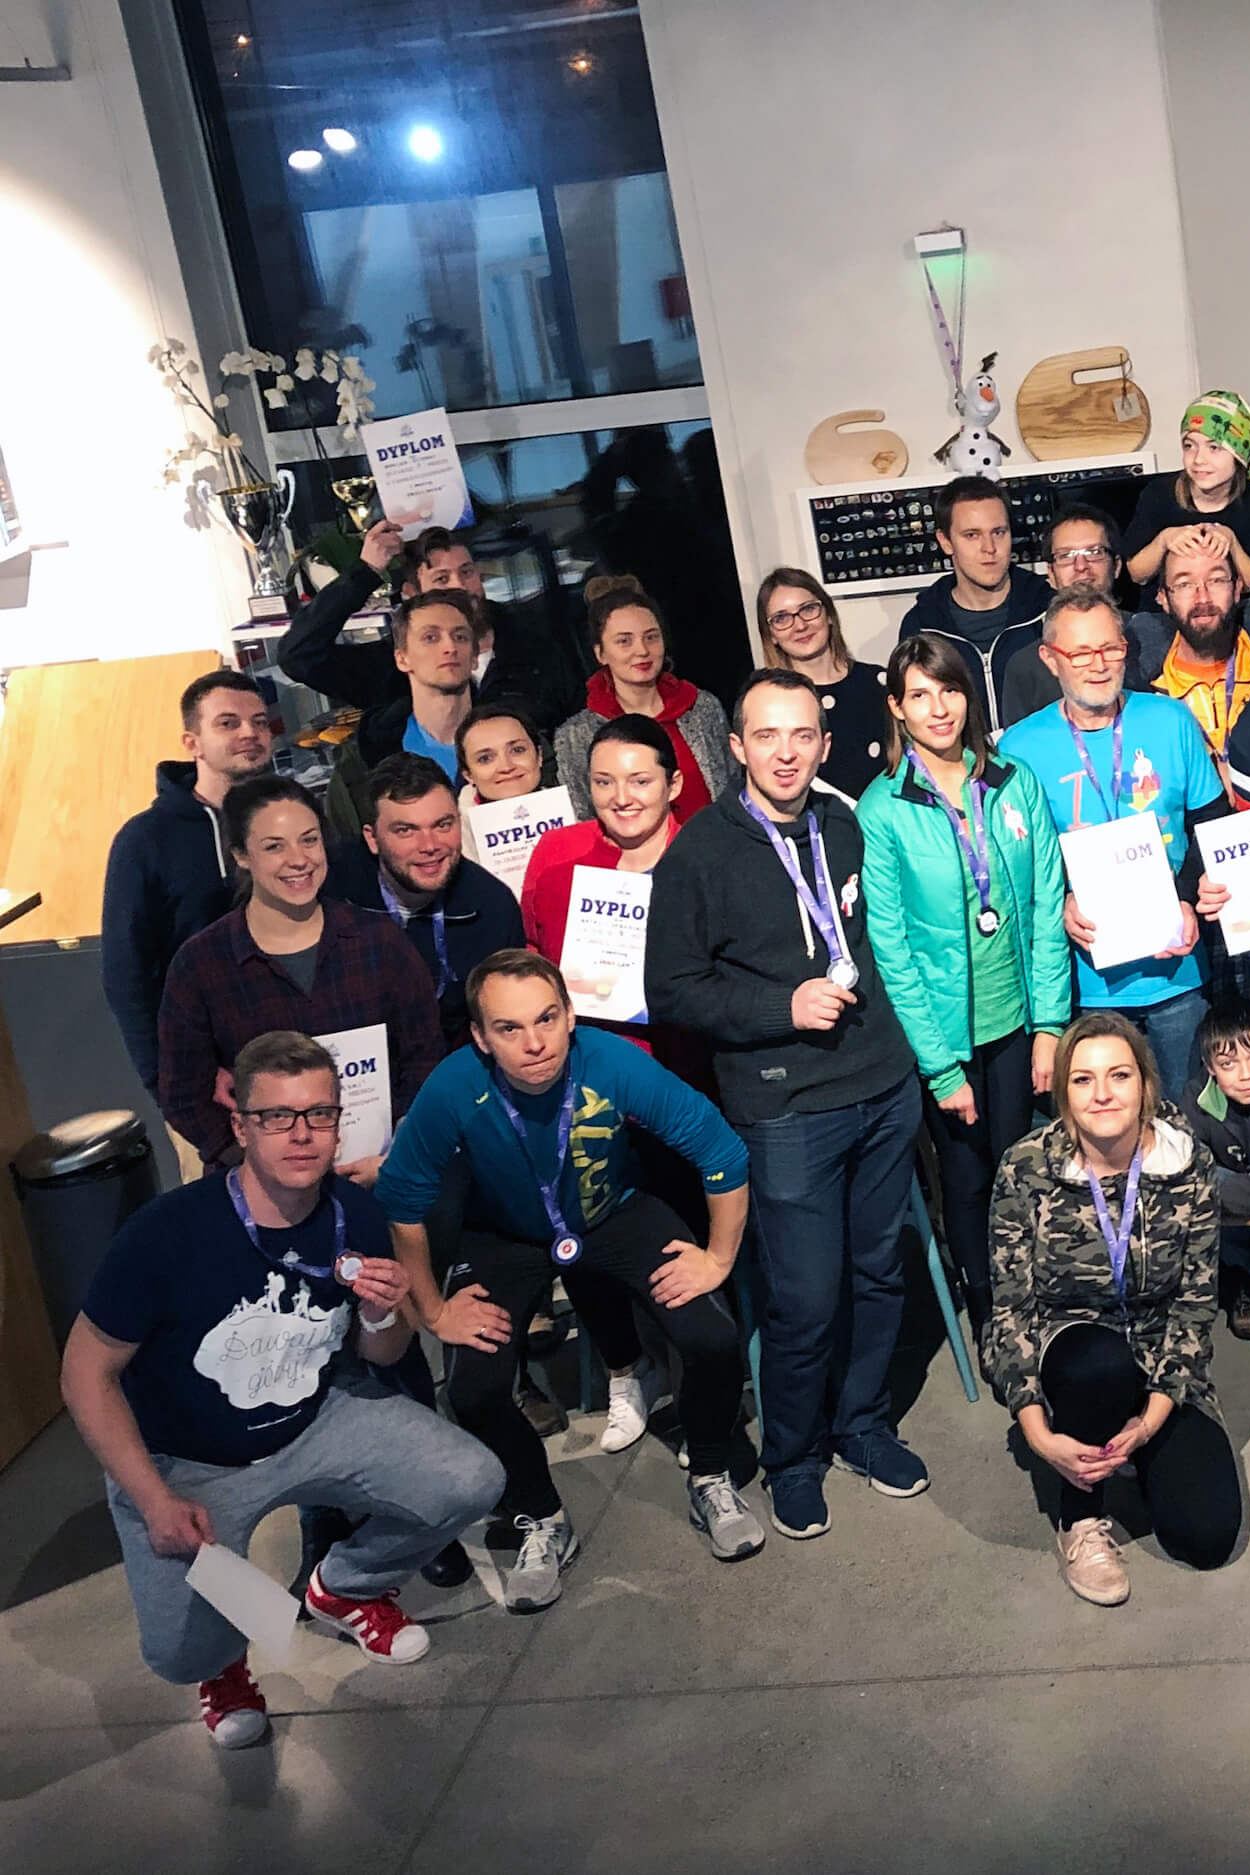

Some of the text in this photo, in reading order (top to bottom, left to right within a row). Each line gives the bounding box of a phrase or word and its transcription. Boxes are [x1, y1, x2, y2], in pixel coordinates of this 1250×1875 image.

[376, 433, 446, 462] DYPLOM
[485, 816, 565, 848] DYPLOM
[1115, 842, 1153, 865] LOM
[580, 897, 646, 921] DYPLO
